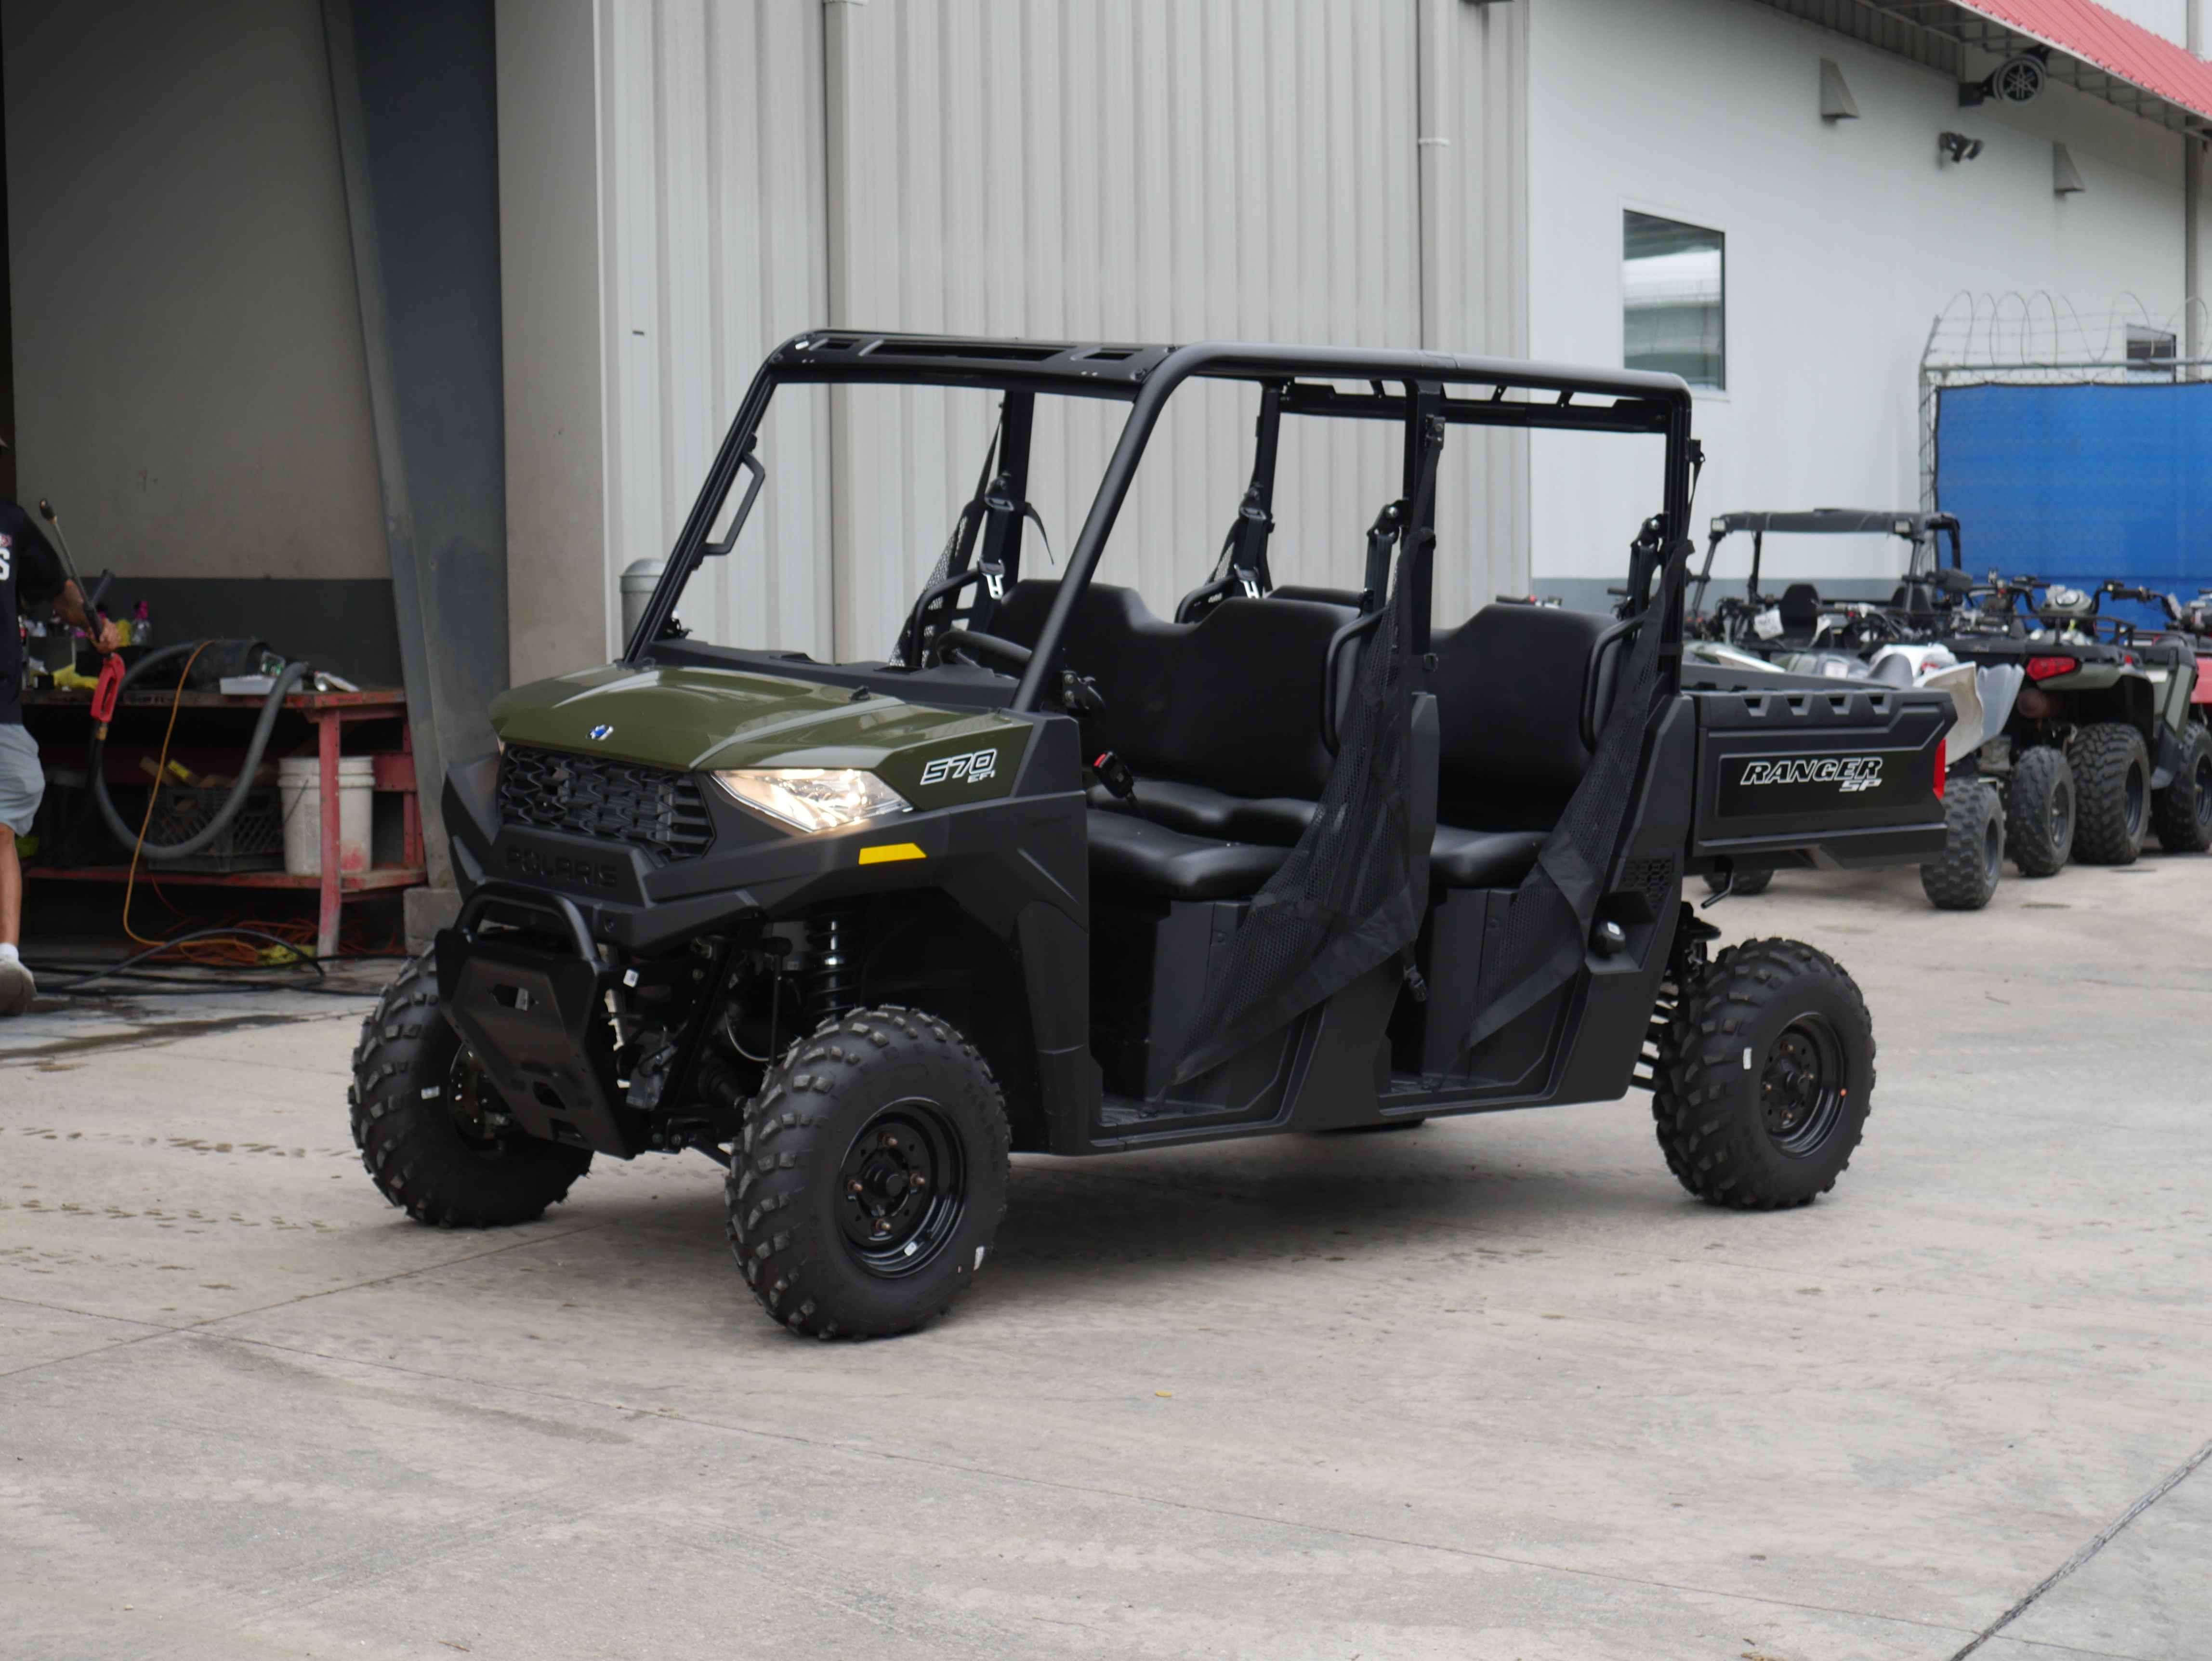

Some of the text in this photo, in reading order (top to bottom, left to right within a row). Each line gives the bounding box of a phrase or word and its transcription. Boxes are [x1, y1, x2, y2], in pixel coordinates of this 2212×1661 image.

[920, 748, 998, 785] 570
[967, 770, 996, 783] EFI
[1740, 756, 1883, 786] RANGER
[1839, 778, 1883, 792] SP
[504, 846, 617, 887] POLARIS
